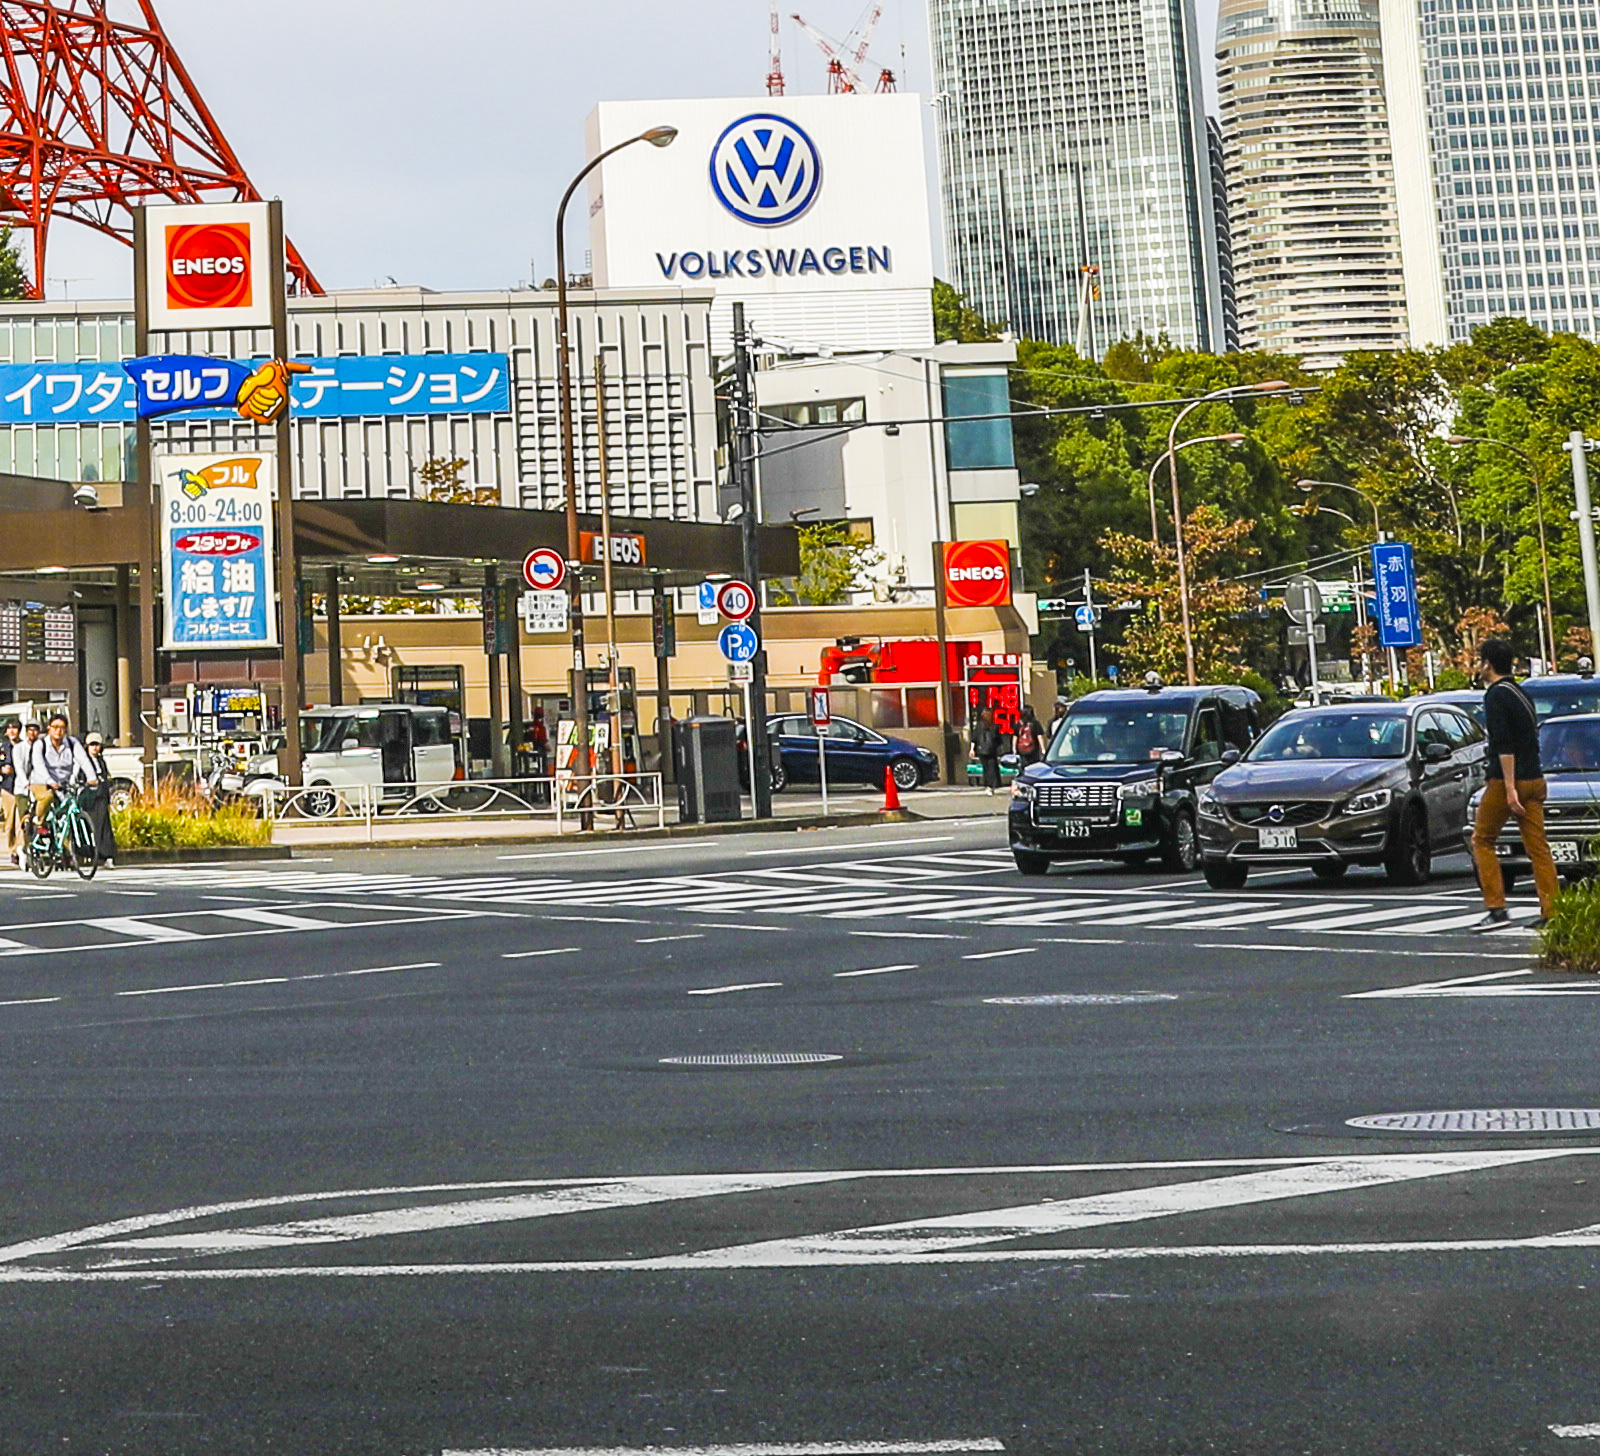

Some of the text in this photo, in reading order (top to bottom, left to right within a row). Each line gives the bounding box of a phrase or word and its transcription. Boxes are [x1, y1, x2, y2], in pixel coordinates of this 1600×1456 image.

[172, 256, 245, 275] ENEOS
[656, 245, 891, 278] VOLKSWAGEN
[141, 367, 229, 401] セルフ
[212, 465, 250, 485] フル
[185, 534, 252, 552] スタッフが
[592, 536, 641, 564] EEOS
[181, 558, 256, 595] 給油
[948, 566, 1005, 582] ENEOS
[725, 592, 746, 610] 40
[1379, 563, 1393, 627] Akabanebashi
[1388, 555, 1410, 633] 赤羽橋
[188, 621, 251, 635] フルサービス
[727, 633, 743, 659] P
